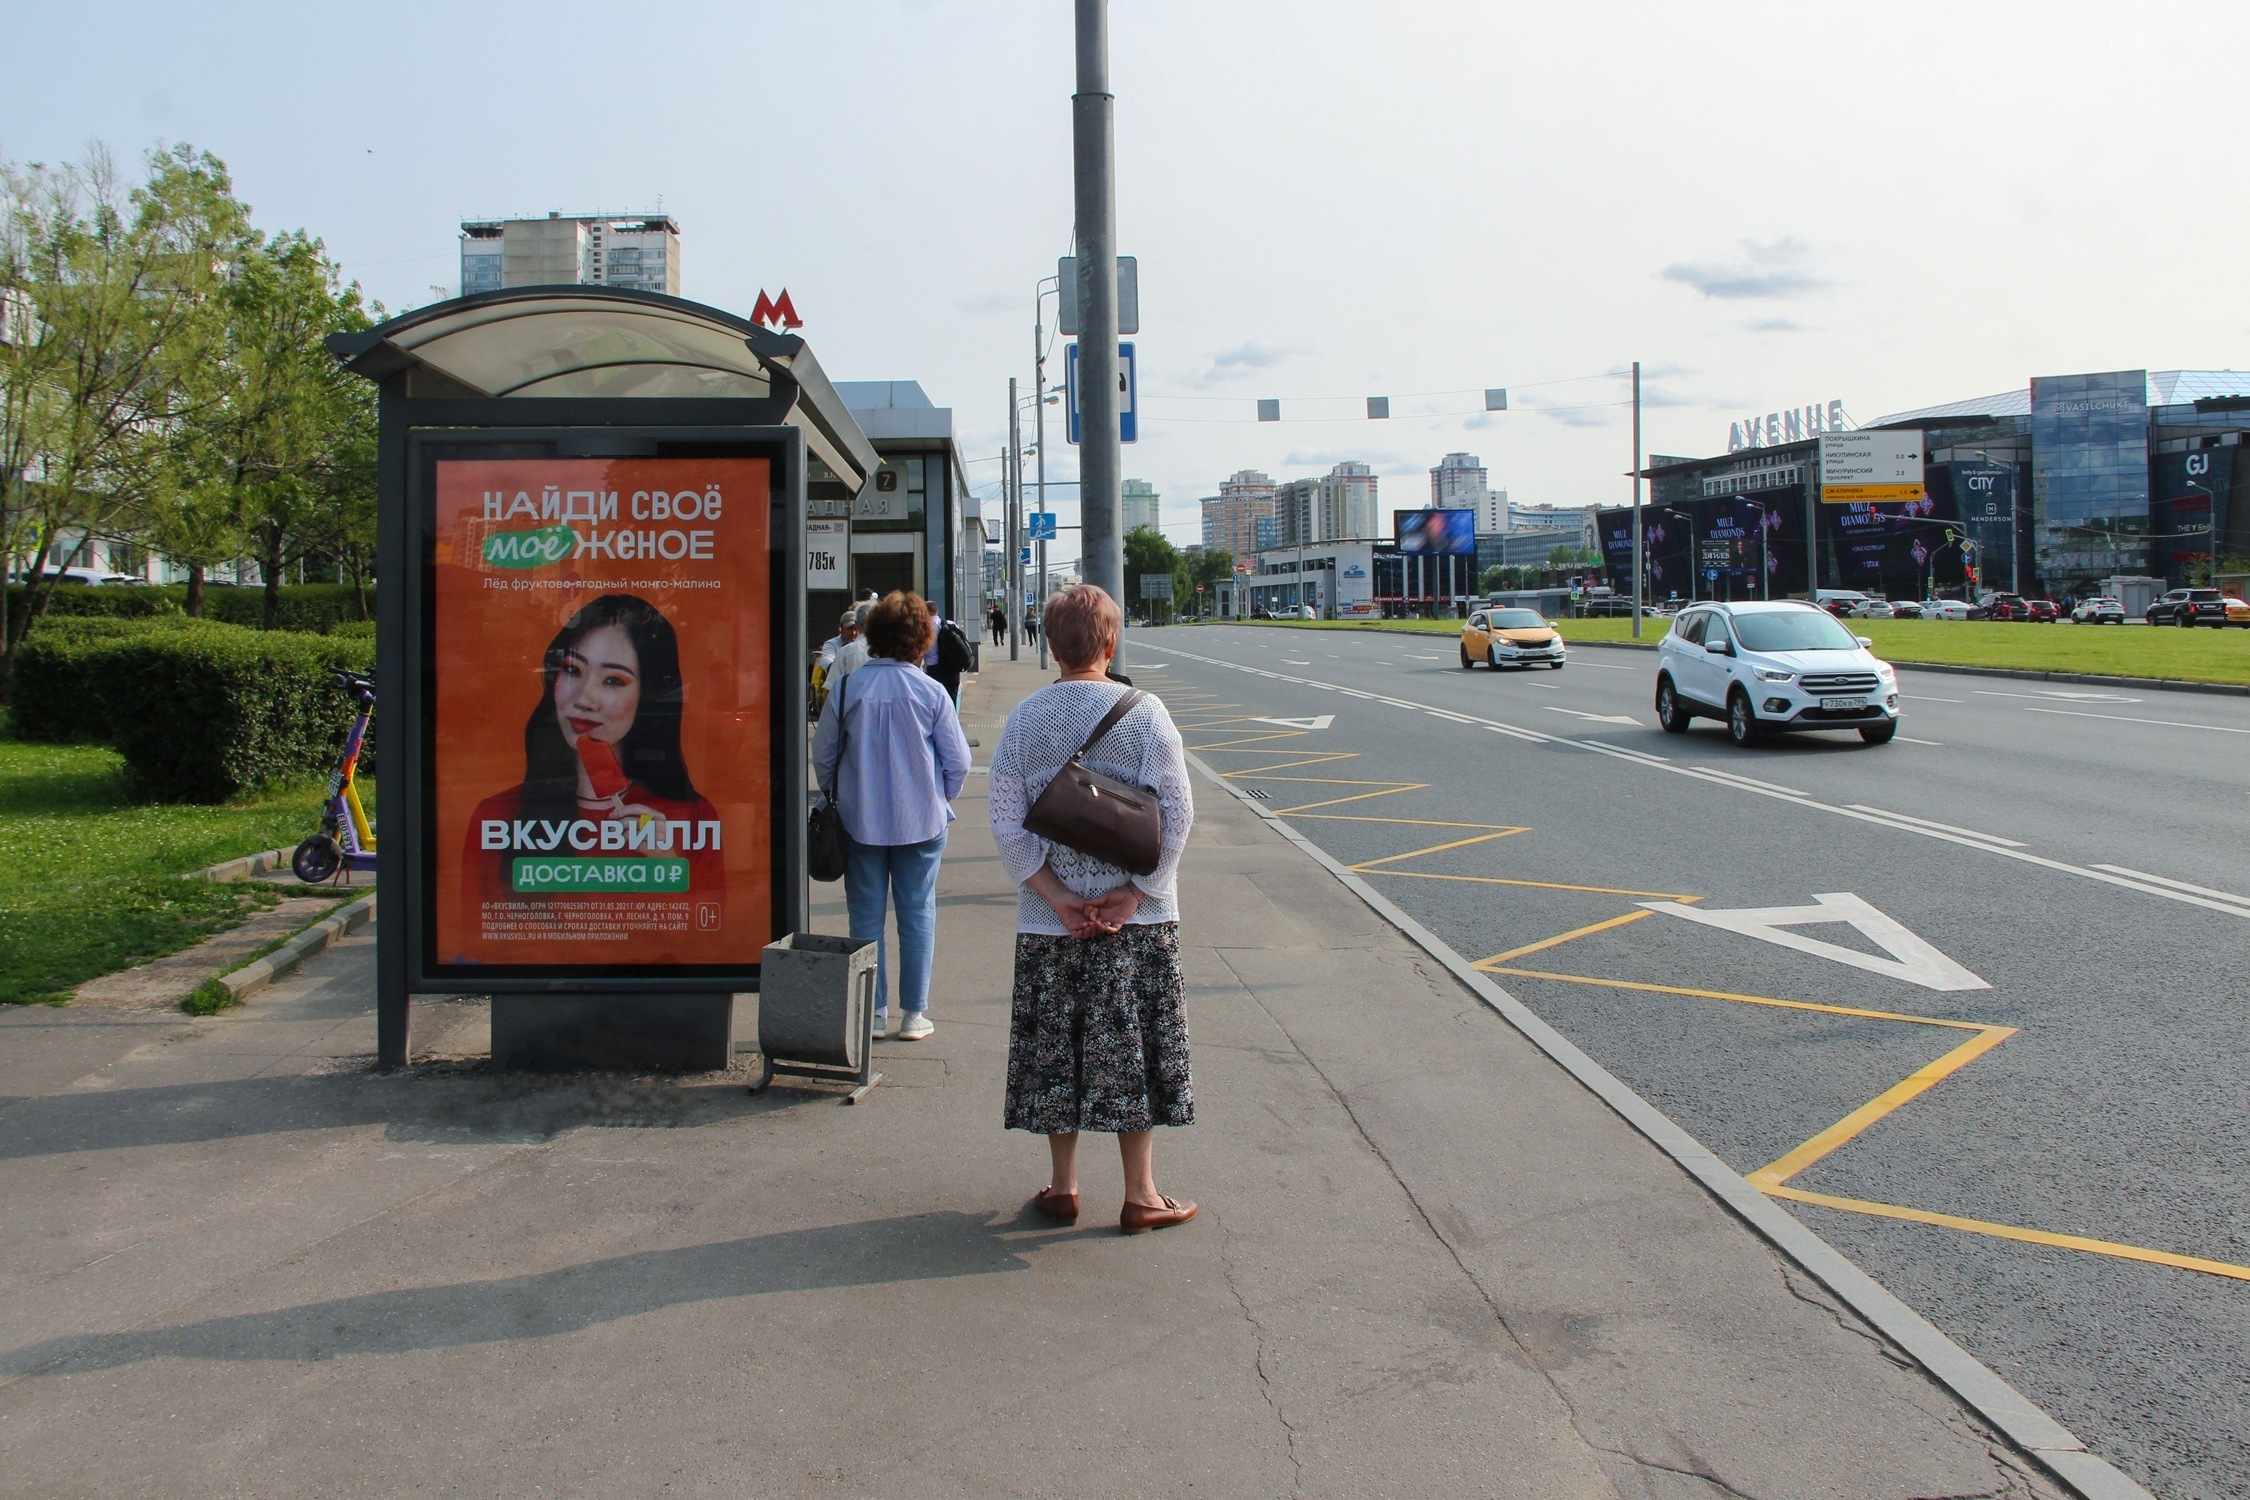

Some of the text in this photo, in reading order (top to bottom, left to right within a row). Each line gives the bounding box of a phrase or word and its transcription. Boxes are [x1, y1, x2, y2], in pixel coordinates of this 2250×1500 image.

[1728, 399, 1842, 453] AVENUE
[2186, 454, 2208, 475] GJ
[883, 474, 890, 486] 7
[1969, 477, 1995, 490] CITY
[484, 485, 618, 526] НАЙДИ
[808, 500, 889, 515] АДНАЯ
[1717, 516, 1734, 527] MIUZ
[1841, 512, 1885, 526] DIAMODS
[1613, 530, 1627, 538] MIUZ
[1710, 527, 1745, 538] DIAMONDS
[1608, 540, 1633, 549] DIAMOND
[484, 577, 721, 590] Лёд фруктово-ягодный манго-малина
[482, 820, 720, 850] ВКУСВИЛЛ
[482, 902, 490, 910] АО
[491, 902, 530, 910] «ВКУСВИЛЛ»,
[531, 902, 546, 910] ОГРН
[647, 903, 668, 911] АДРЕС:
[669, 903, 690, 911] 142432,
[482, 912, 494, 920] МО,
[495, 912, 505, 920] Г.О.
[507, 912, 557, 920] ЧЕРНОГОЛОВКА,
[626, 913, 651, 921] ЛЕСНАЯ,
[653, 913, 660, 921] Д.
[700, 906, 716, 927] 0+
[482, 922, 517, 930] ПОДРОБНЕЕ
[518, 922, 524, 930] О
[525, 922, 556, 930] СПОСОБАХ
[588, 923, 621, 931] ДОСТАВКИ
[622, 922, 657, 930] УТОЧНЯЙТЕ
[669, 922, 688, 930] САЙТЕ
